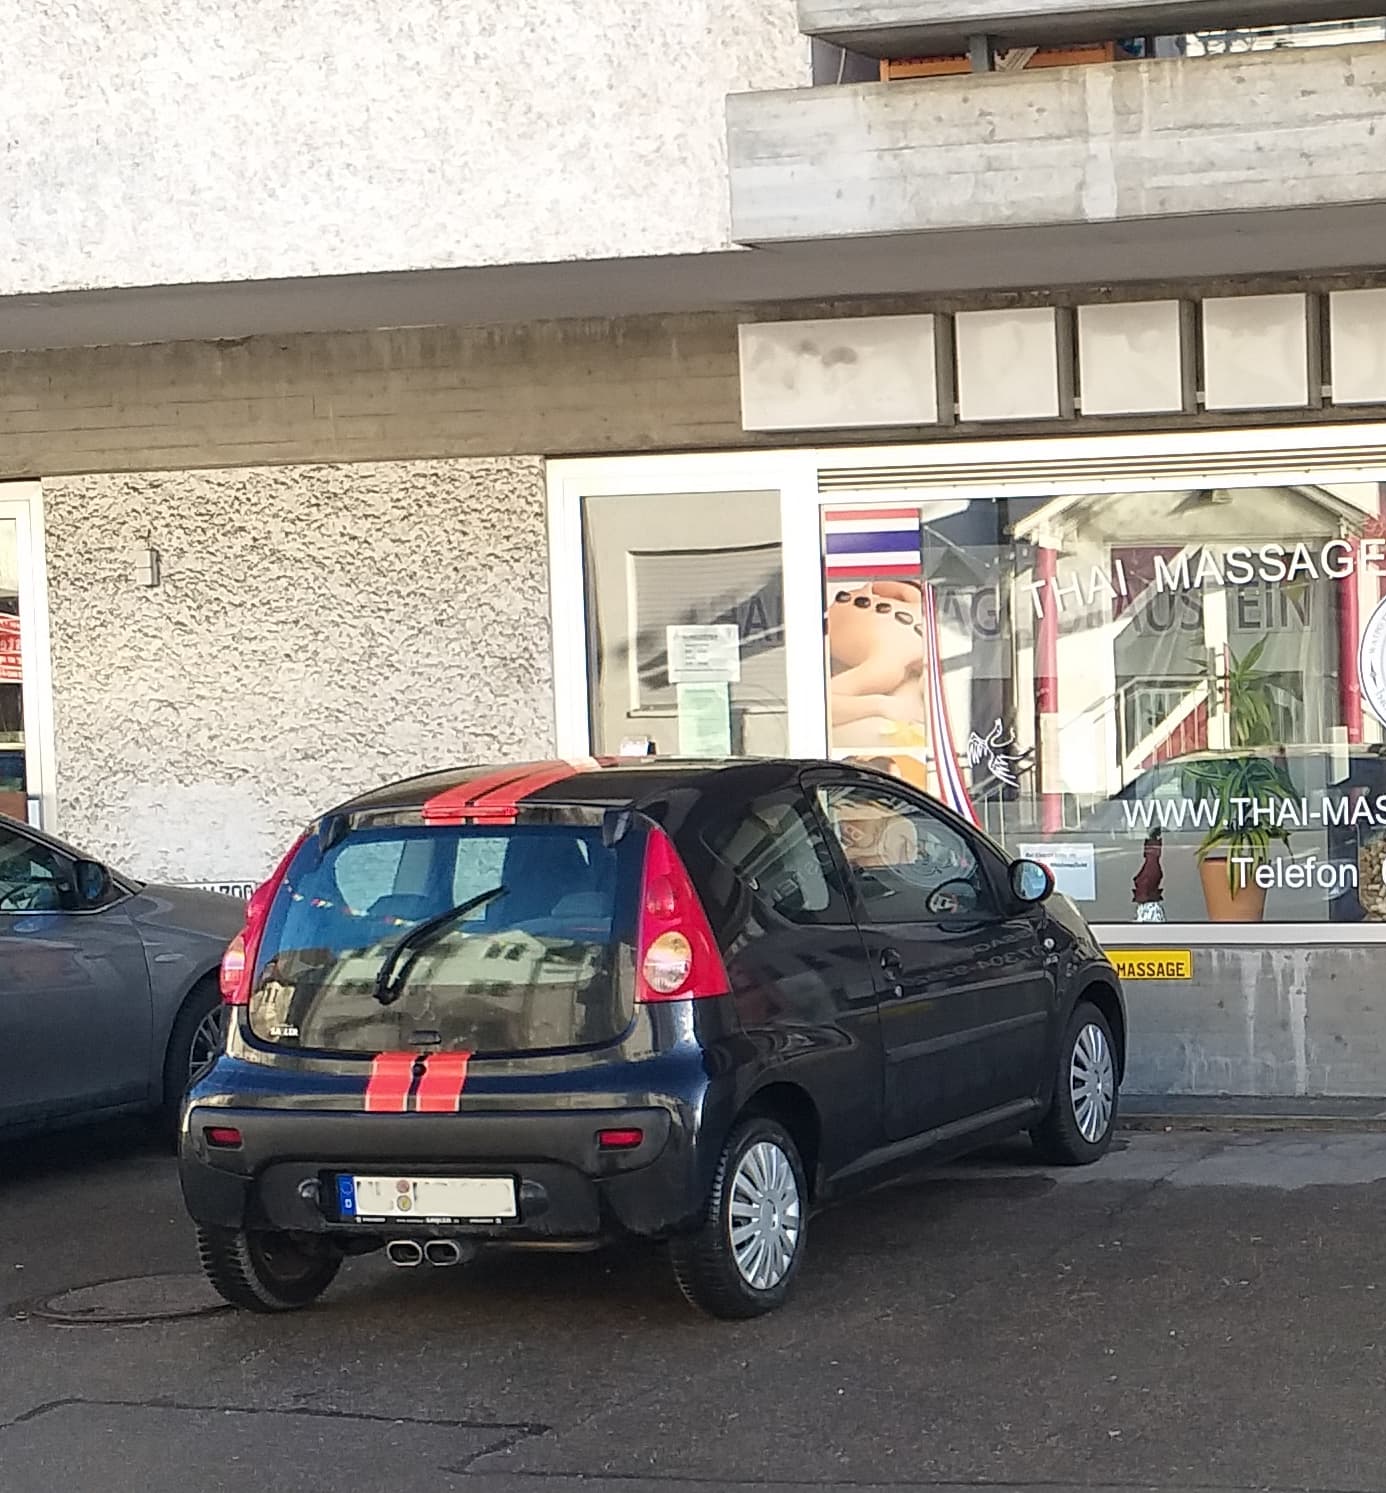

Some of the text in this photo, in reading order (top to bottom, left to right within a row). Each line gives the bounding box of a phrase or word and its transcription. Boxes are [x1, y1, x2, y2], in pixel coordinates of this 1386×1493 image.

[1021, 559, 1129, 619] THAI
[1231, 856, 1359, 889] Telefon
[1116, 961, 1185, 977] MASSAGE
